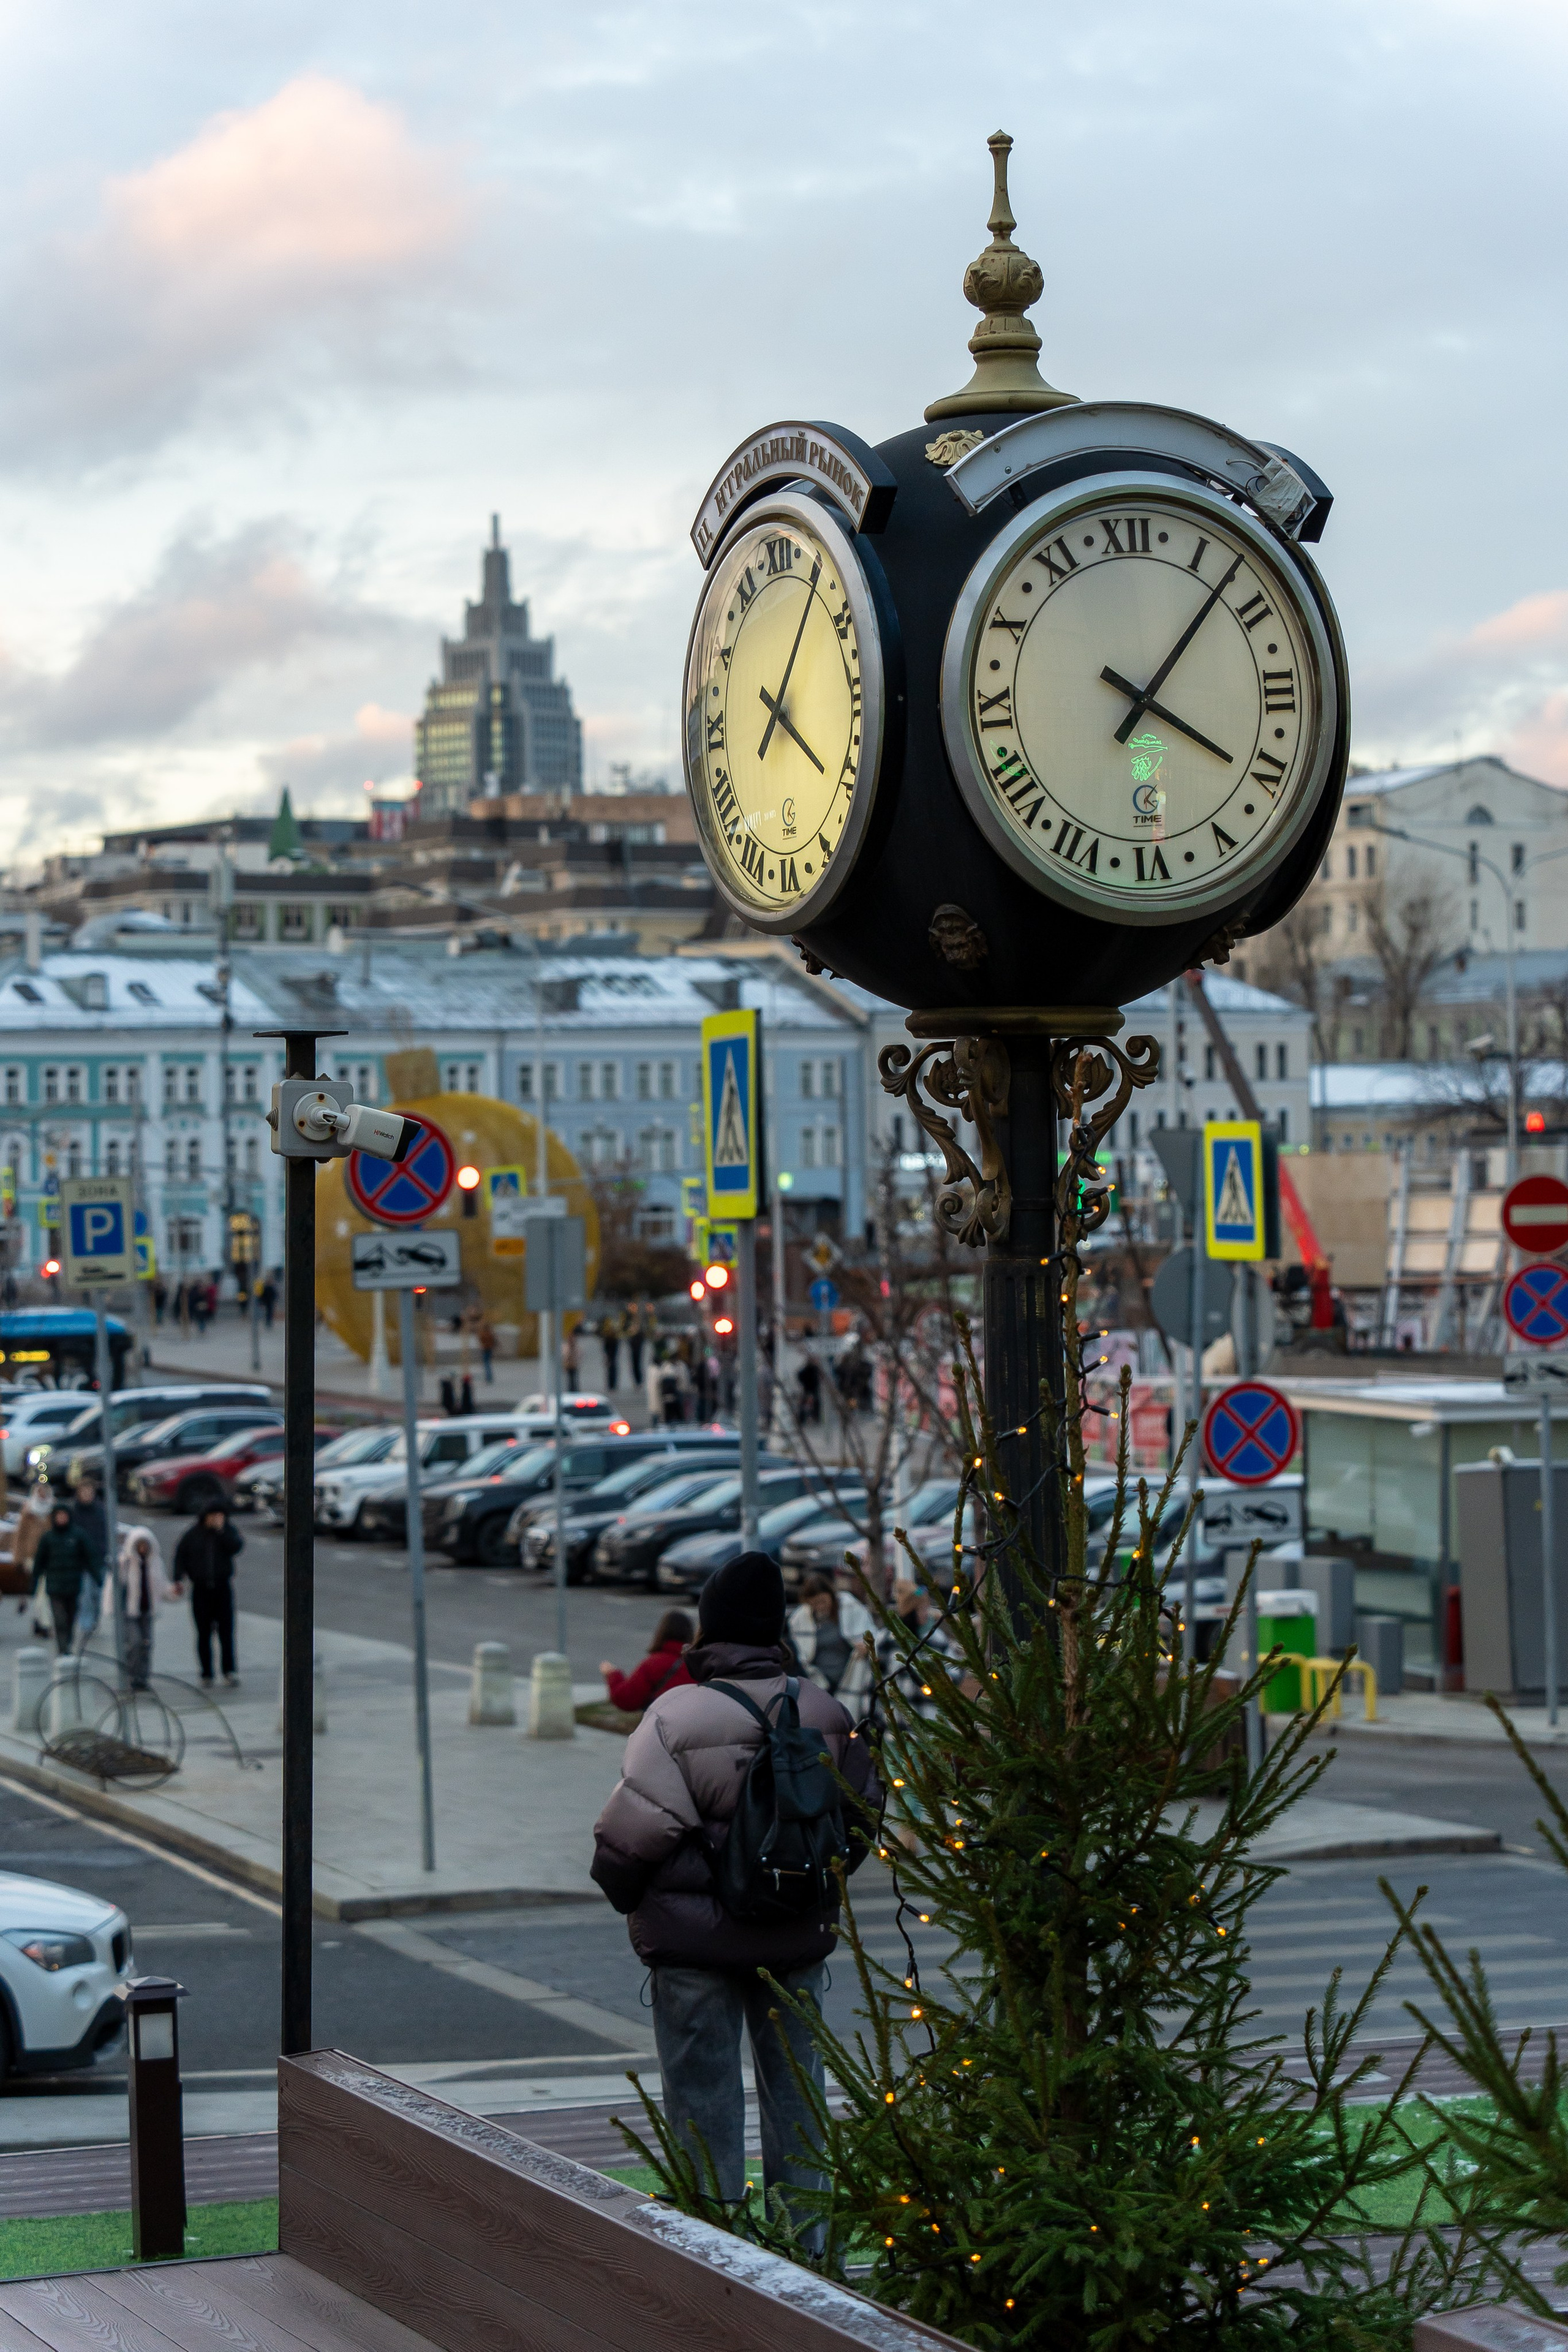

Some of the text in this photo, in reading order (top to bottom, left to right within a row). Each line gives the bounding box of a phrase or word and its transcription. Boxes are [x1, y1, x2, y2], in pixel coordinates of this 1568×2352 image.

[697, 431, 864, 552] ЦНТРАЛЬНЫЙ РЫНОК
[766, 537, 793, 576] XII
[1098, 518, 1153, 554] XII
[1188, 537, 1210, 572] I
[1032, 535, 1080, 587] XI
[734, 564, 756, 613] XI
[989, 606, 1027, 644] X
[1235, 590, 1273, 633] II
[978, 687, 1014, 732] IX
[1263, 668, 1295, 715] III
[707, 710, 725, 753] IX
[990, 750, 1046, 829] VIII
[1250, 748, 1287, 799] IV
[712, 770, 740, 846] VIII
[1133, 815, 1162, 824] TIME
[782, 826, 797, 837] TIME
[1050, 820, 1100, 875] VII
[1212, 822, 1238, 858] V
[739, 834, 764, 887] VII
[779, 857, 801, 893] VI
[1133, 846, 1172, 881] VI
[374, 1129, 394, 1140] HiWatch
[84, 1208, 115, 1252] P
